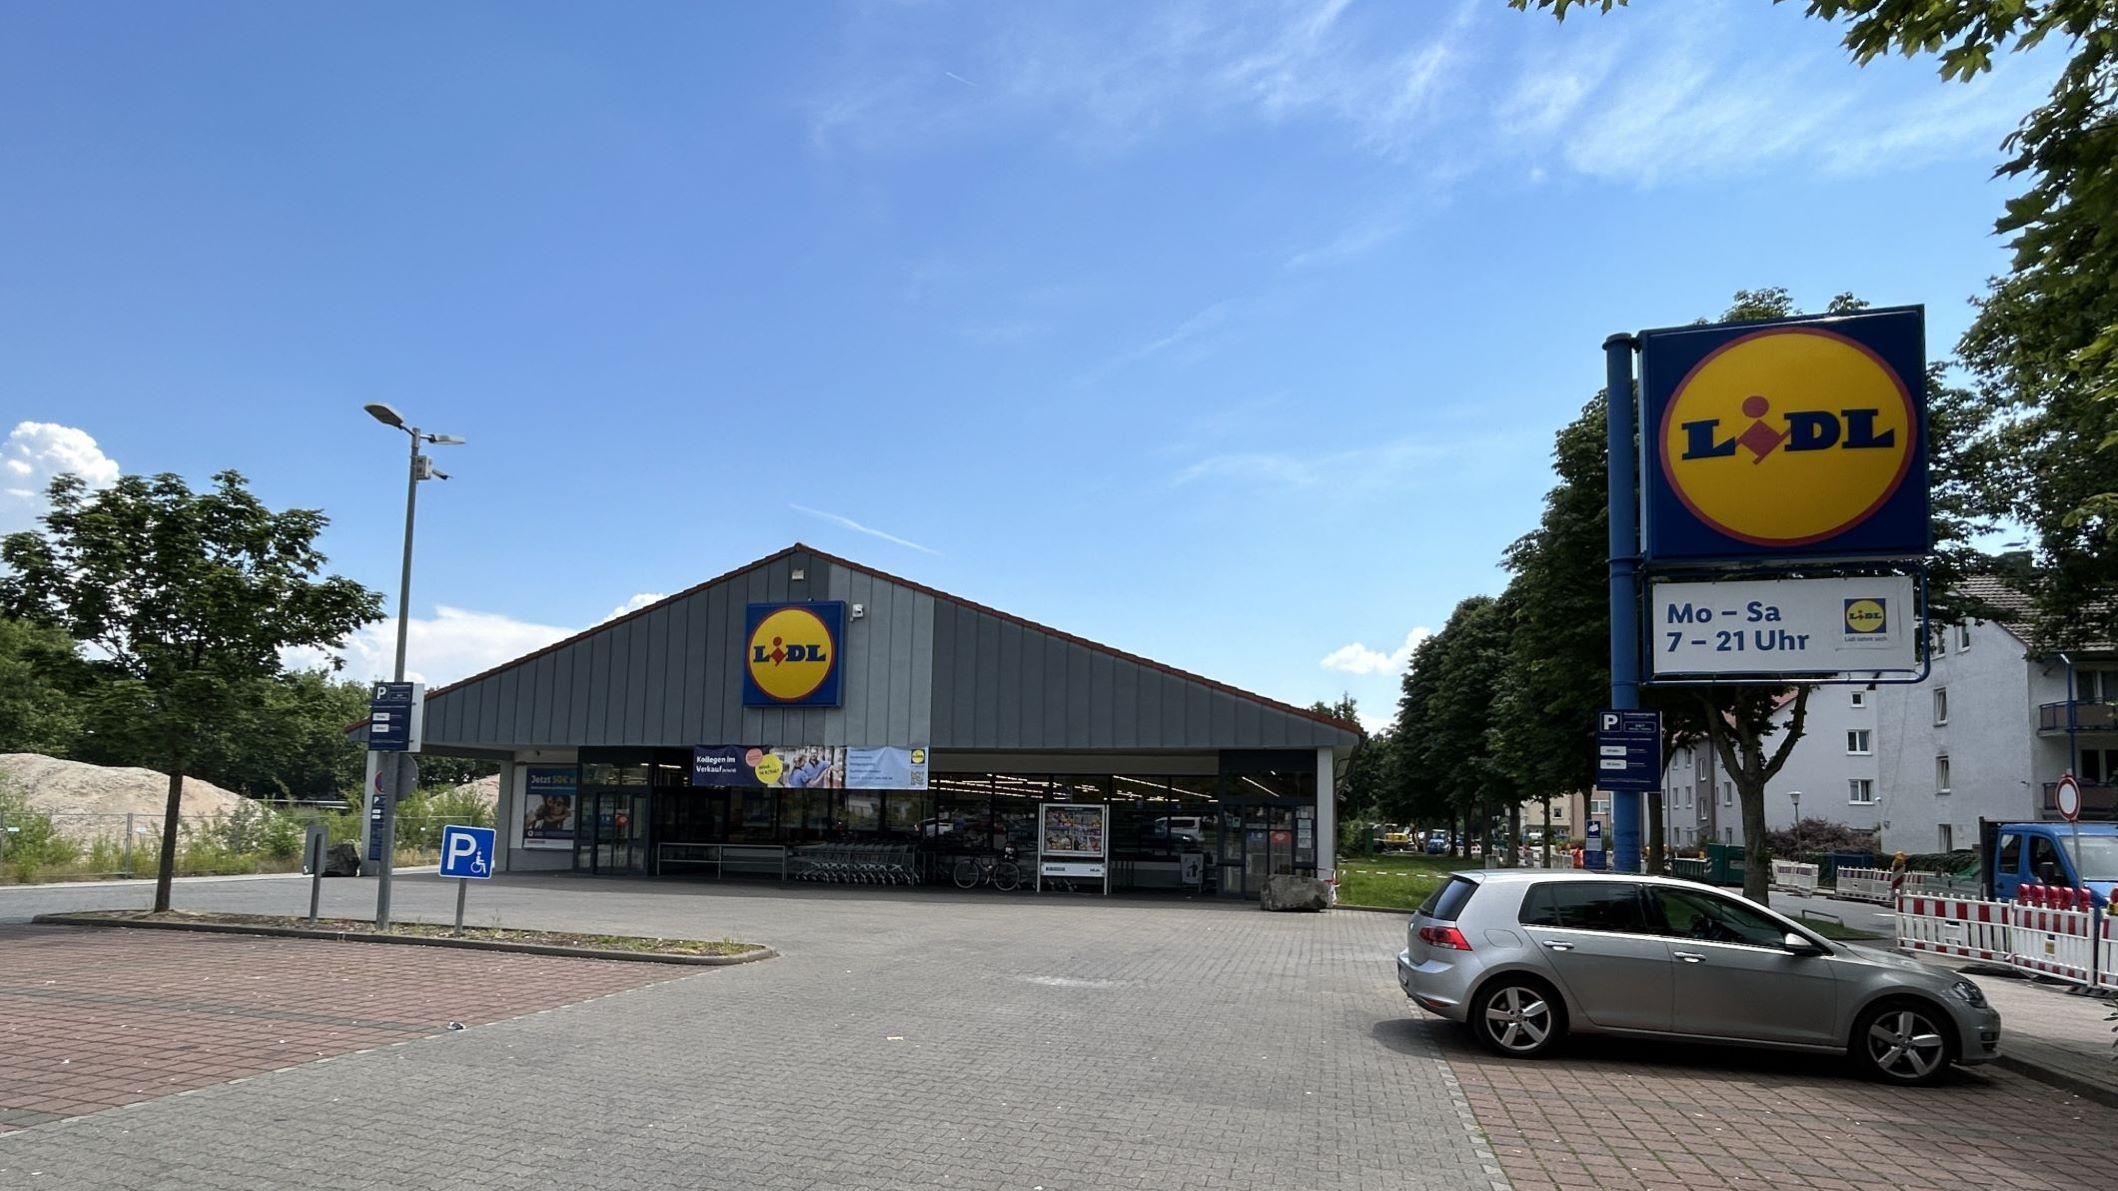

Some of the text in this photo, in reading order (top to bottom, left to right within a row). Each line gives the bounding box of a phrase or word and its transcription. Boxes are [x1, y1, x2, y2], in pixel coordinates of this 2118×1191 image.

[1667, 603, 1712, 623] Mo
[1747, 601, 1781, 622] Sa
[1667, 632, 1682, 652] 7
[1716, 631, 1744, 651] 21
[1755, 630, 1809, 651] Uhr
[376, 686, 387, 699] P
[1603, 714, 1618, 730] P
[696, 755, 736, 764] Kollegen im
[696, 765, 722, 773] Verkauf
[531, 775, 551, 783] Jetzt
[447, 833, 477, 870] P
